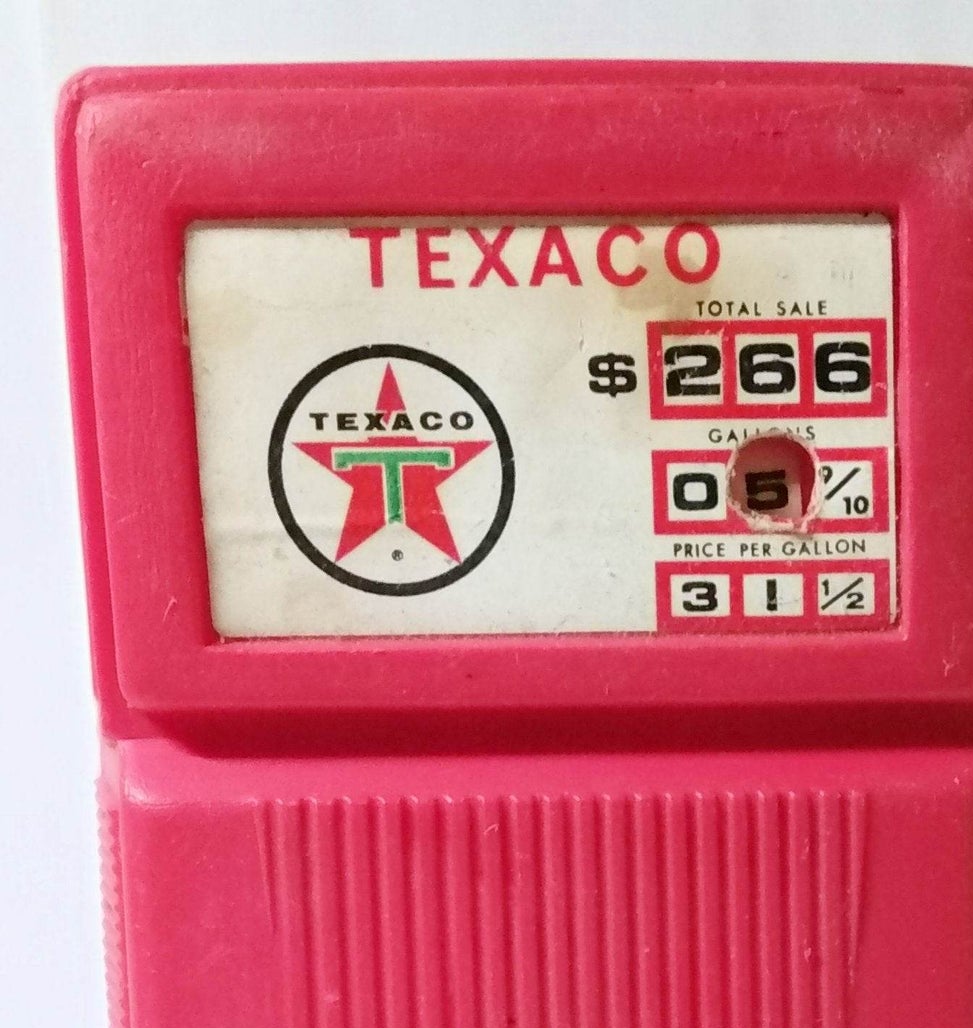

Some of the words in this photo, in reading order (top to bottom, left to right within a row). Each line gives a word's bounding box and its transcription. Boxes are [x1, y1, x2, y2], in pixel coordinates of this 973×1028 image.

[348, 222, 721, 289] TEXACO
[696, 300, 761, 317] TOTAL
[776, 300, 828, 316] SALE
[309, 410, 475, 432] TEXACO
[672, 542, 725, 558] PRICE
[739, 541, 771, 557] PER
[781, 539, 866, 557] GALLON
